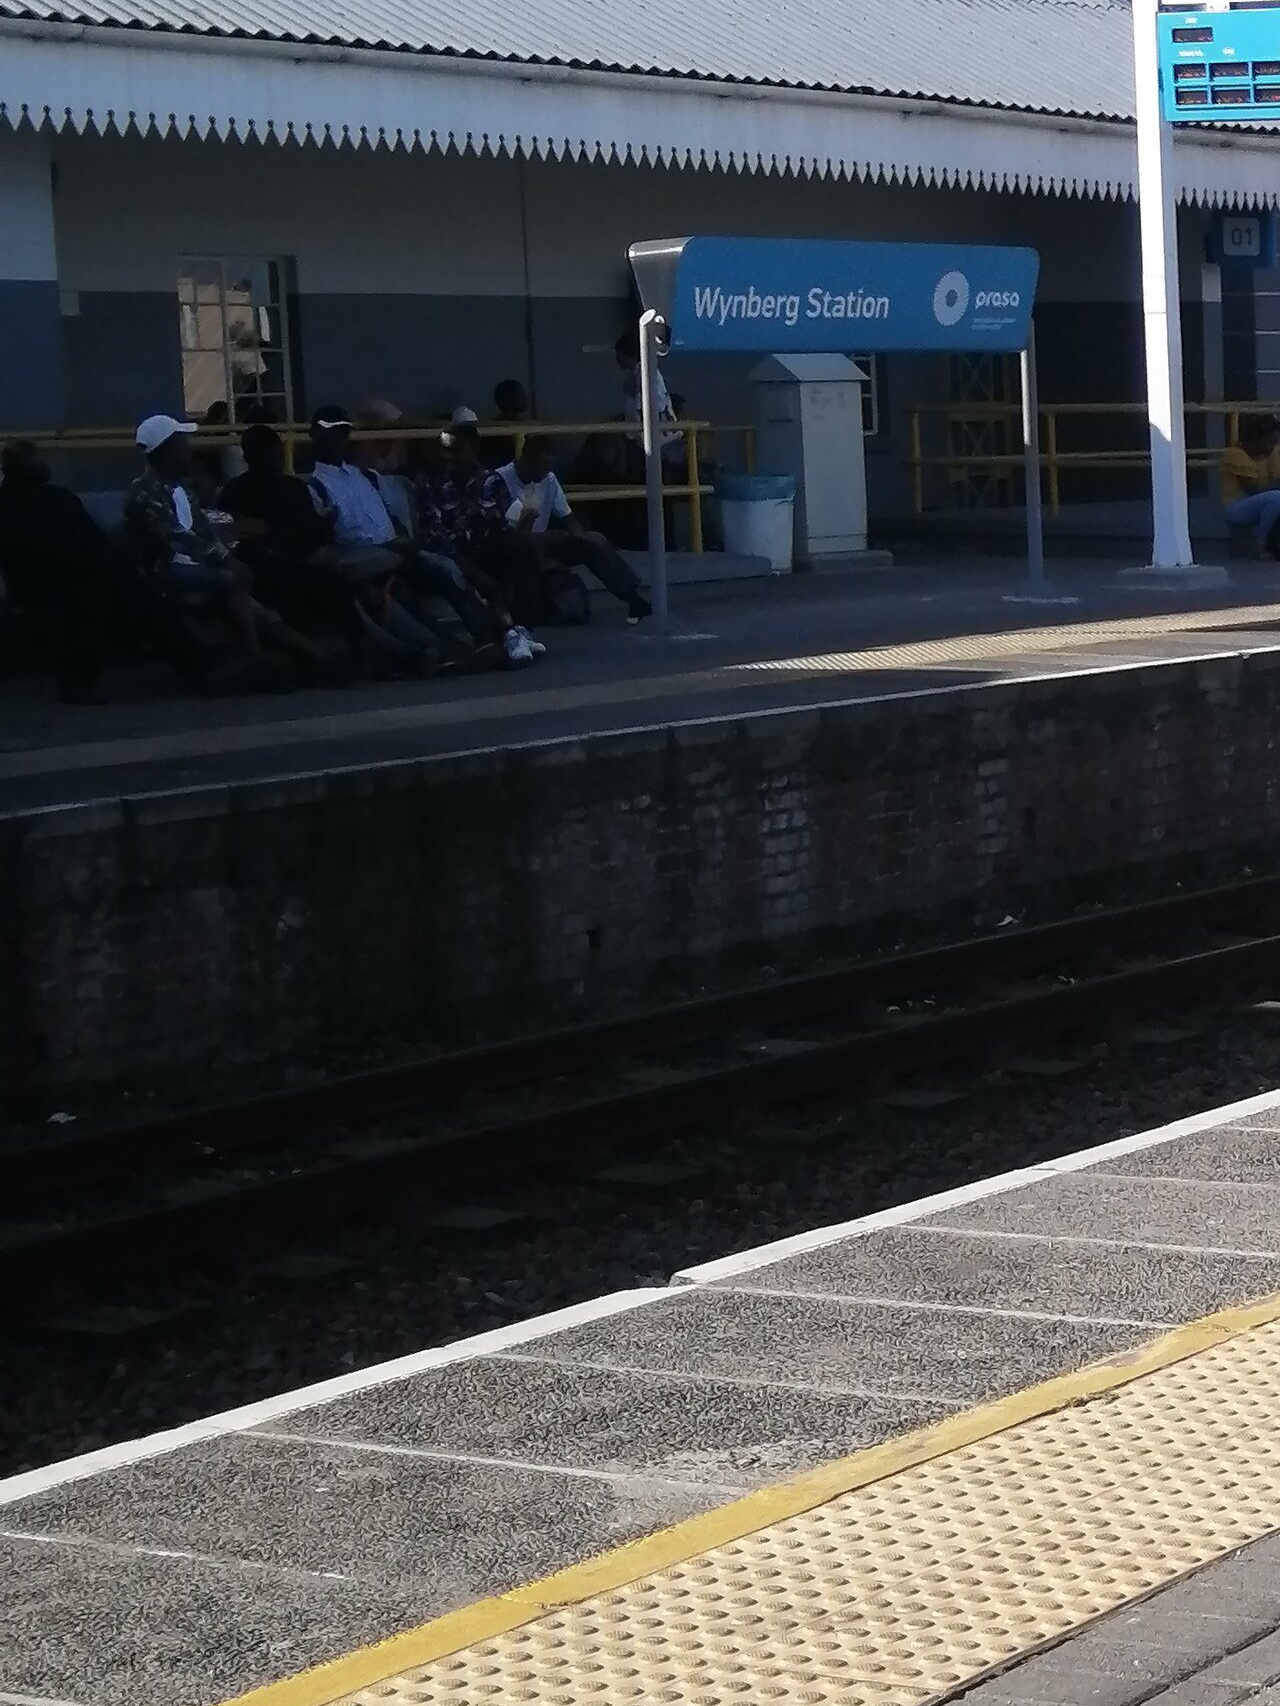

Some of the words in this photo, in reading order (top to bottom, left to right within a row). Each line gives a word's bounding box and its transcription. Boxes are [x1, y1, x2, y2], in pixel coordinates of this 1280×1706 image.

[694, 286, 800, 326] Wynberg
[805, 288, 890, 319] Station
[974, 290, 1021, 309] prasa
